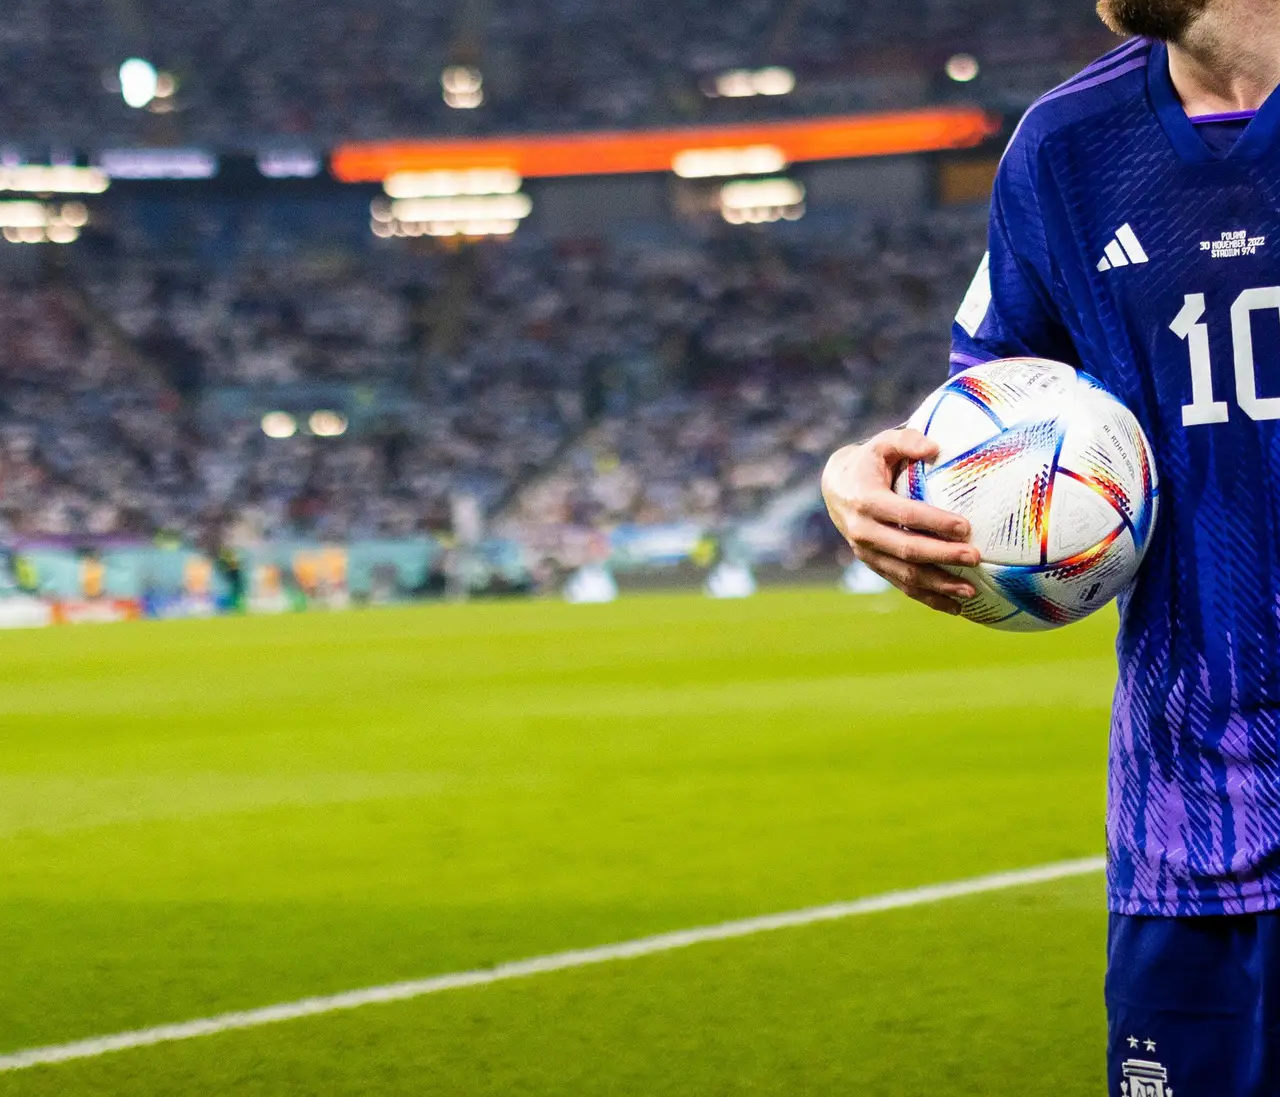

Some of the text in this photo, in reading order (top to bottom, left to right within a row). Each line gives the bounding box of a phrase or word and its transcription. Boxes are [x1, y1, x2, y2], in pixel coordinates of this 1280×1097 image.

[1221, 230, 1246, 241] POLAND
[1200, 236, 1265, 250] 30 NOVEMBER 2022
[1211, 245, 1255, 258] STADIUM 974
